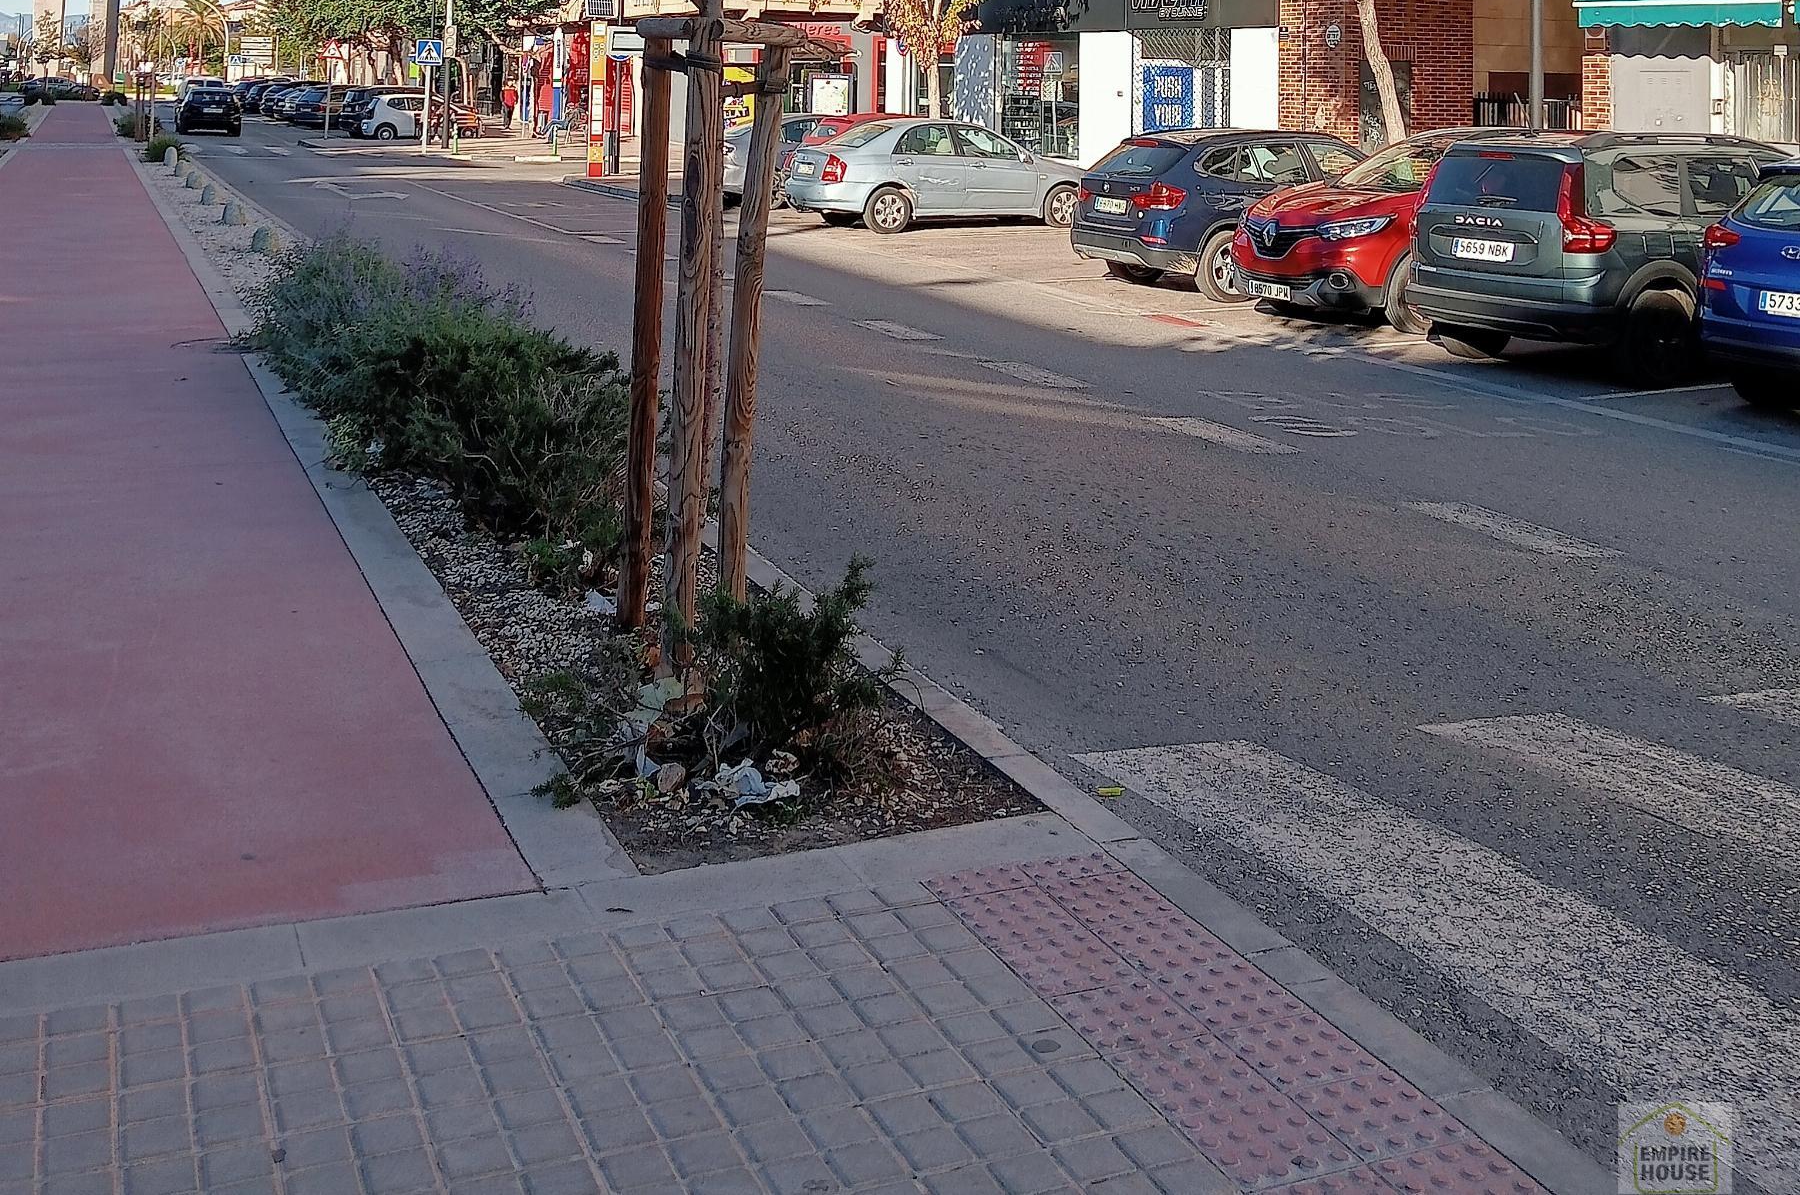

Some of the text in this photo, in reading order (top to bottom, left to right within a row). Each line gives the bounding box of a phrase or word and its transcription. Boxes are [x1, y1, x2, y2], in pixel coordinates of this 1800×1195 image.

[1154, 75, 1182, 98] PUSH
[1153, 103, 1182, 126] YOUR
[1455, 215, 1502, 226] DACIA
[1460, 240, 1508, 257] 5659 NBK
[1769, 293, 1800, 311] 5733
